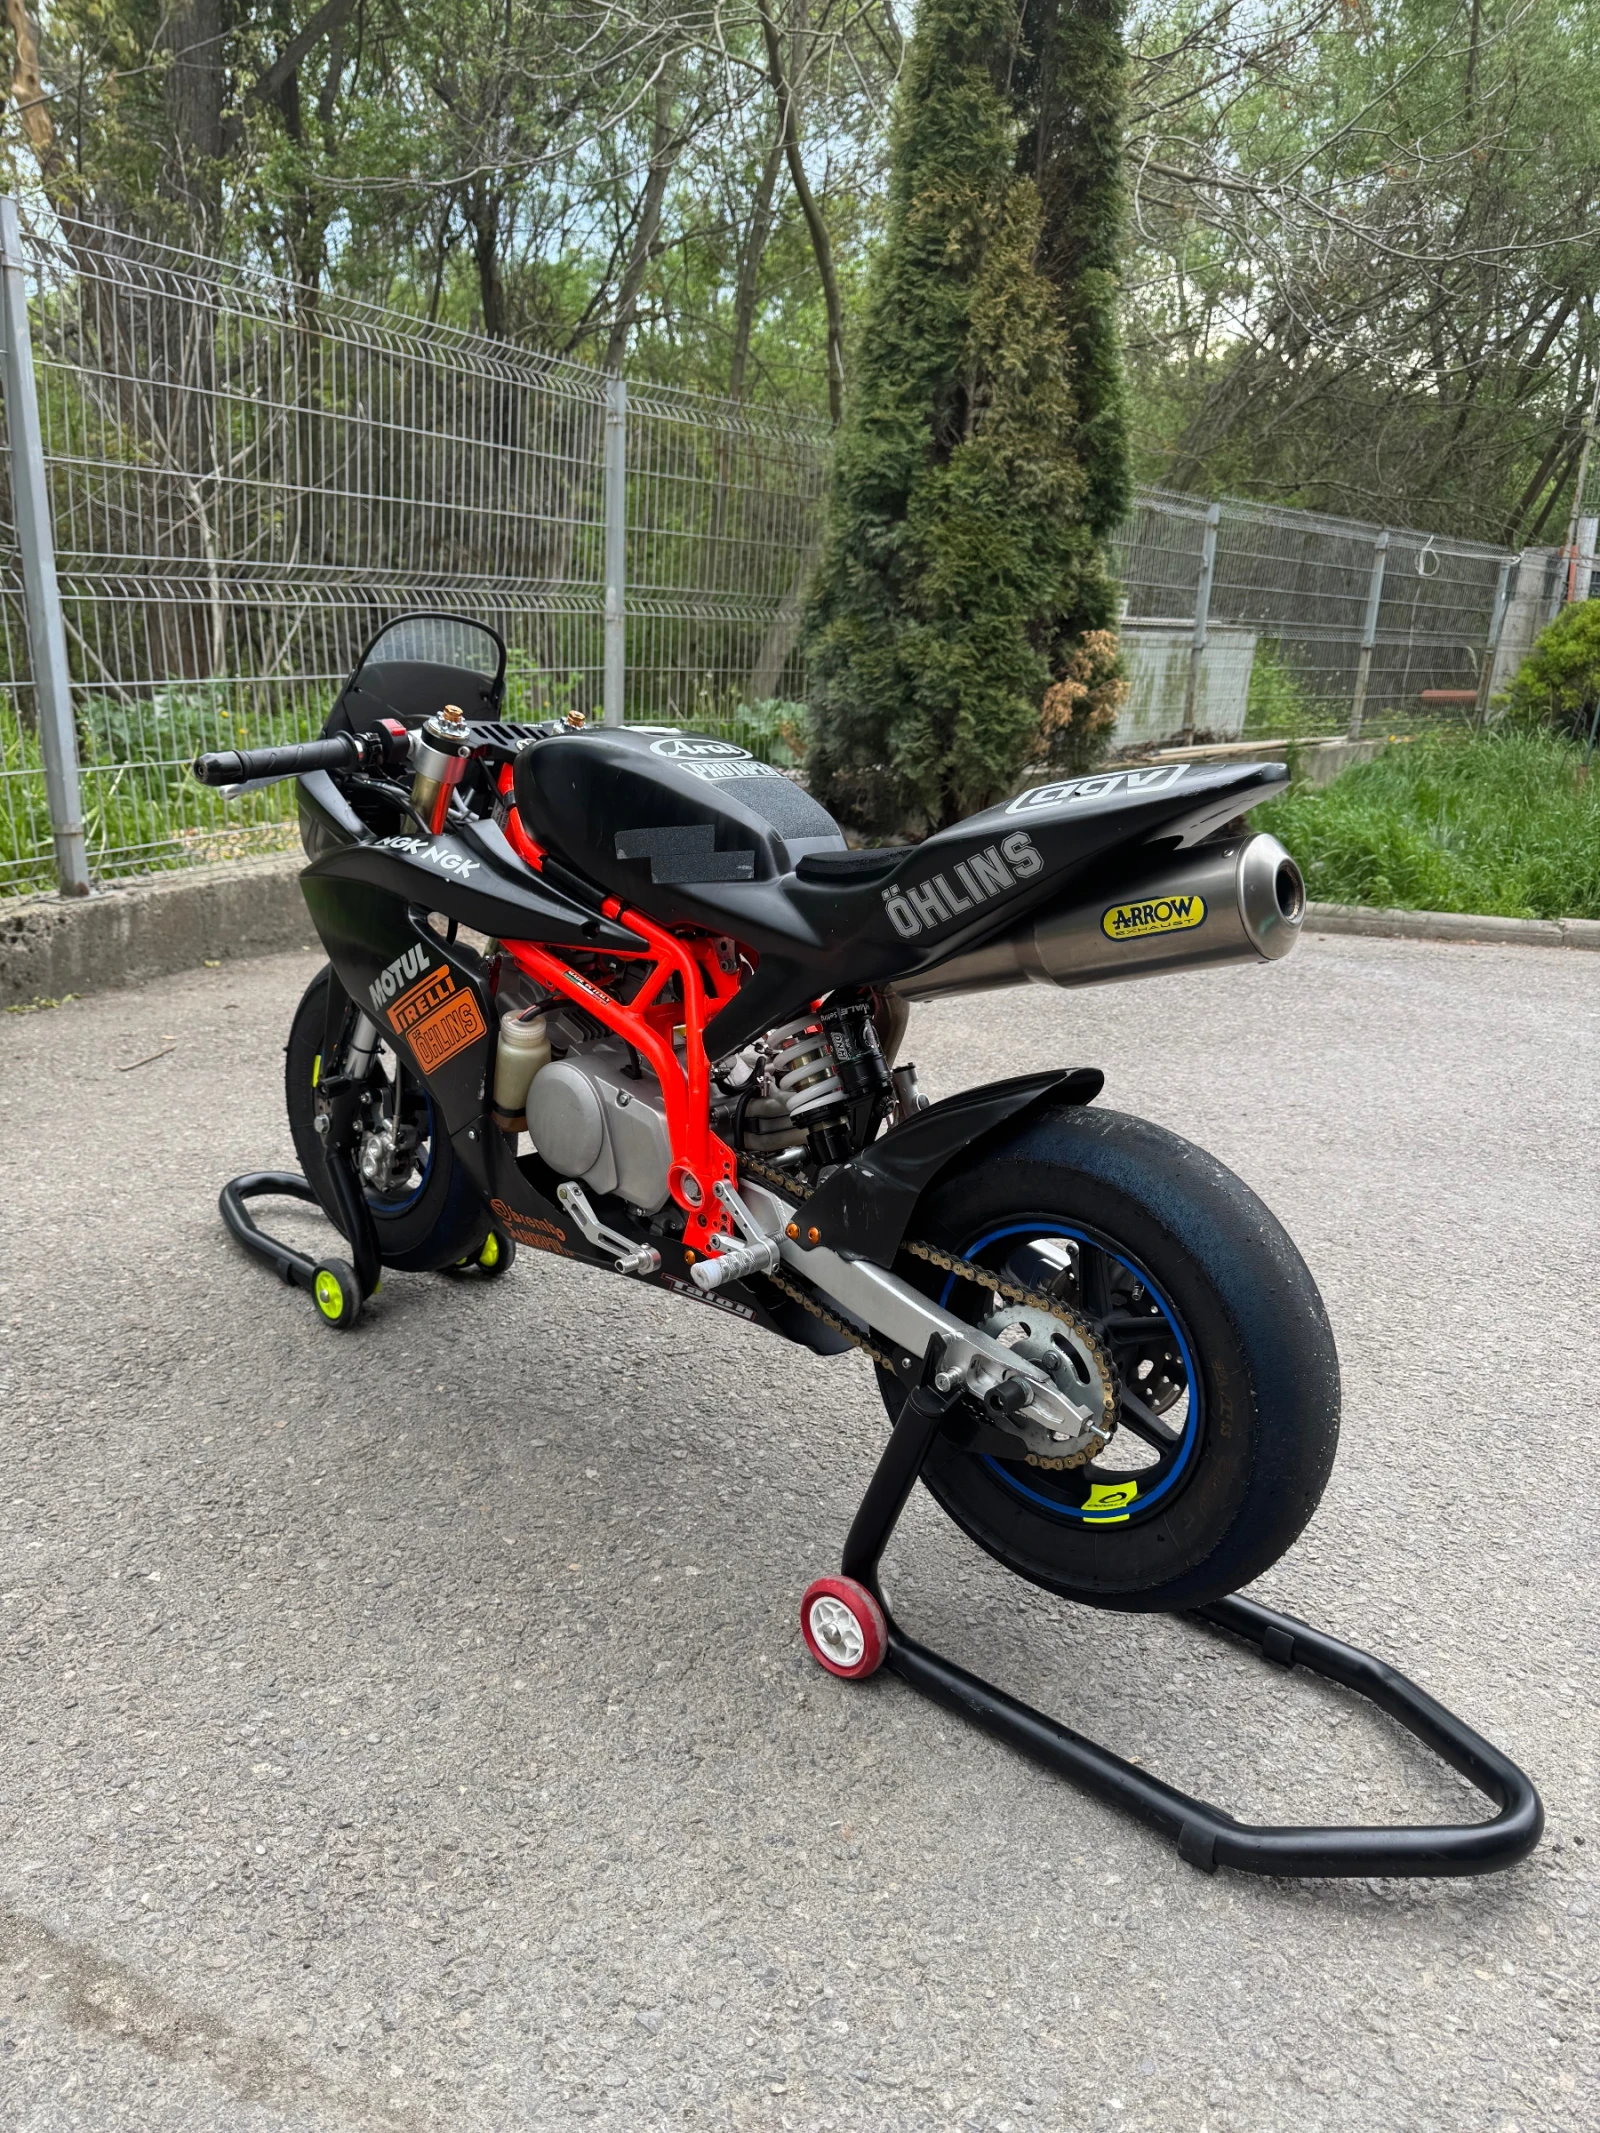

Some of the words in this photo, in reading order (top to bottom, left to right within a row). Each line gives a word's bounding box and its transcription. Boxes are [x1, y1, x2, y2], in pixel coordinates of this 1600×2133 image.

[666, 740, 742, 757] Arai
[1029, 769, 1168, 803] agv
[374, 836, 429, 855] NGK
[420, 845, 481, 879] NGK
[882, 831, 1045, 939] ÖHLINS
[1112, 896, 1195, 930] ARROW
[1115, 918, 1195, 937] EXHAUST
[368, 942, 431, 1012] MOTUL
[386, 963, 456, 1035] PIRELLI
[412, 1002, 478, 1065] ÖHLINS
[507, 1205, 567, 1242] brembo
